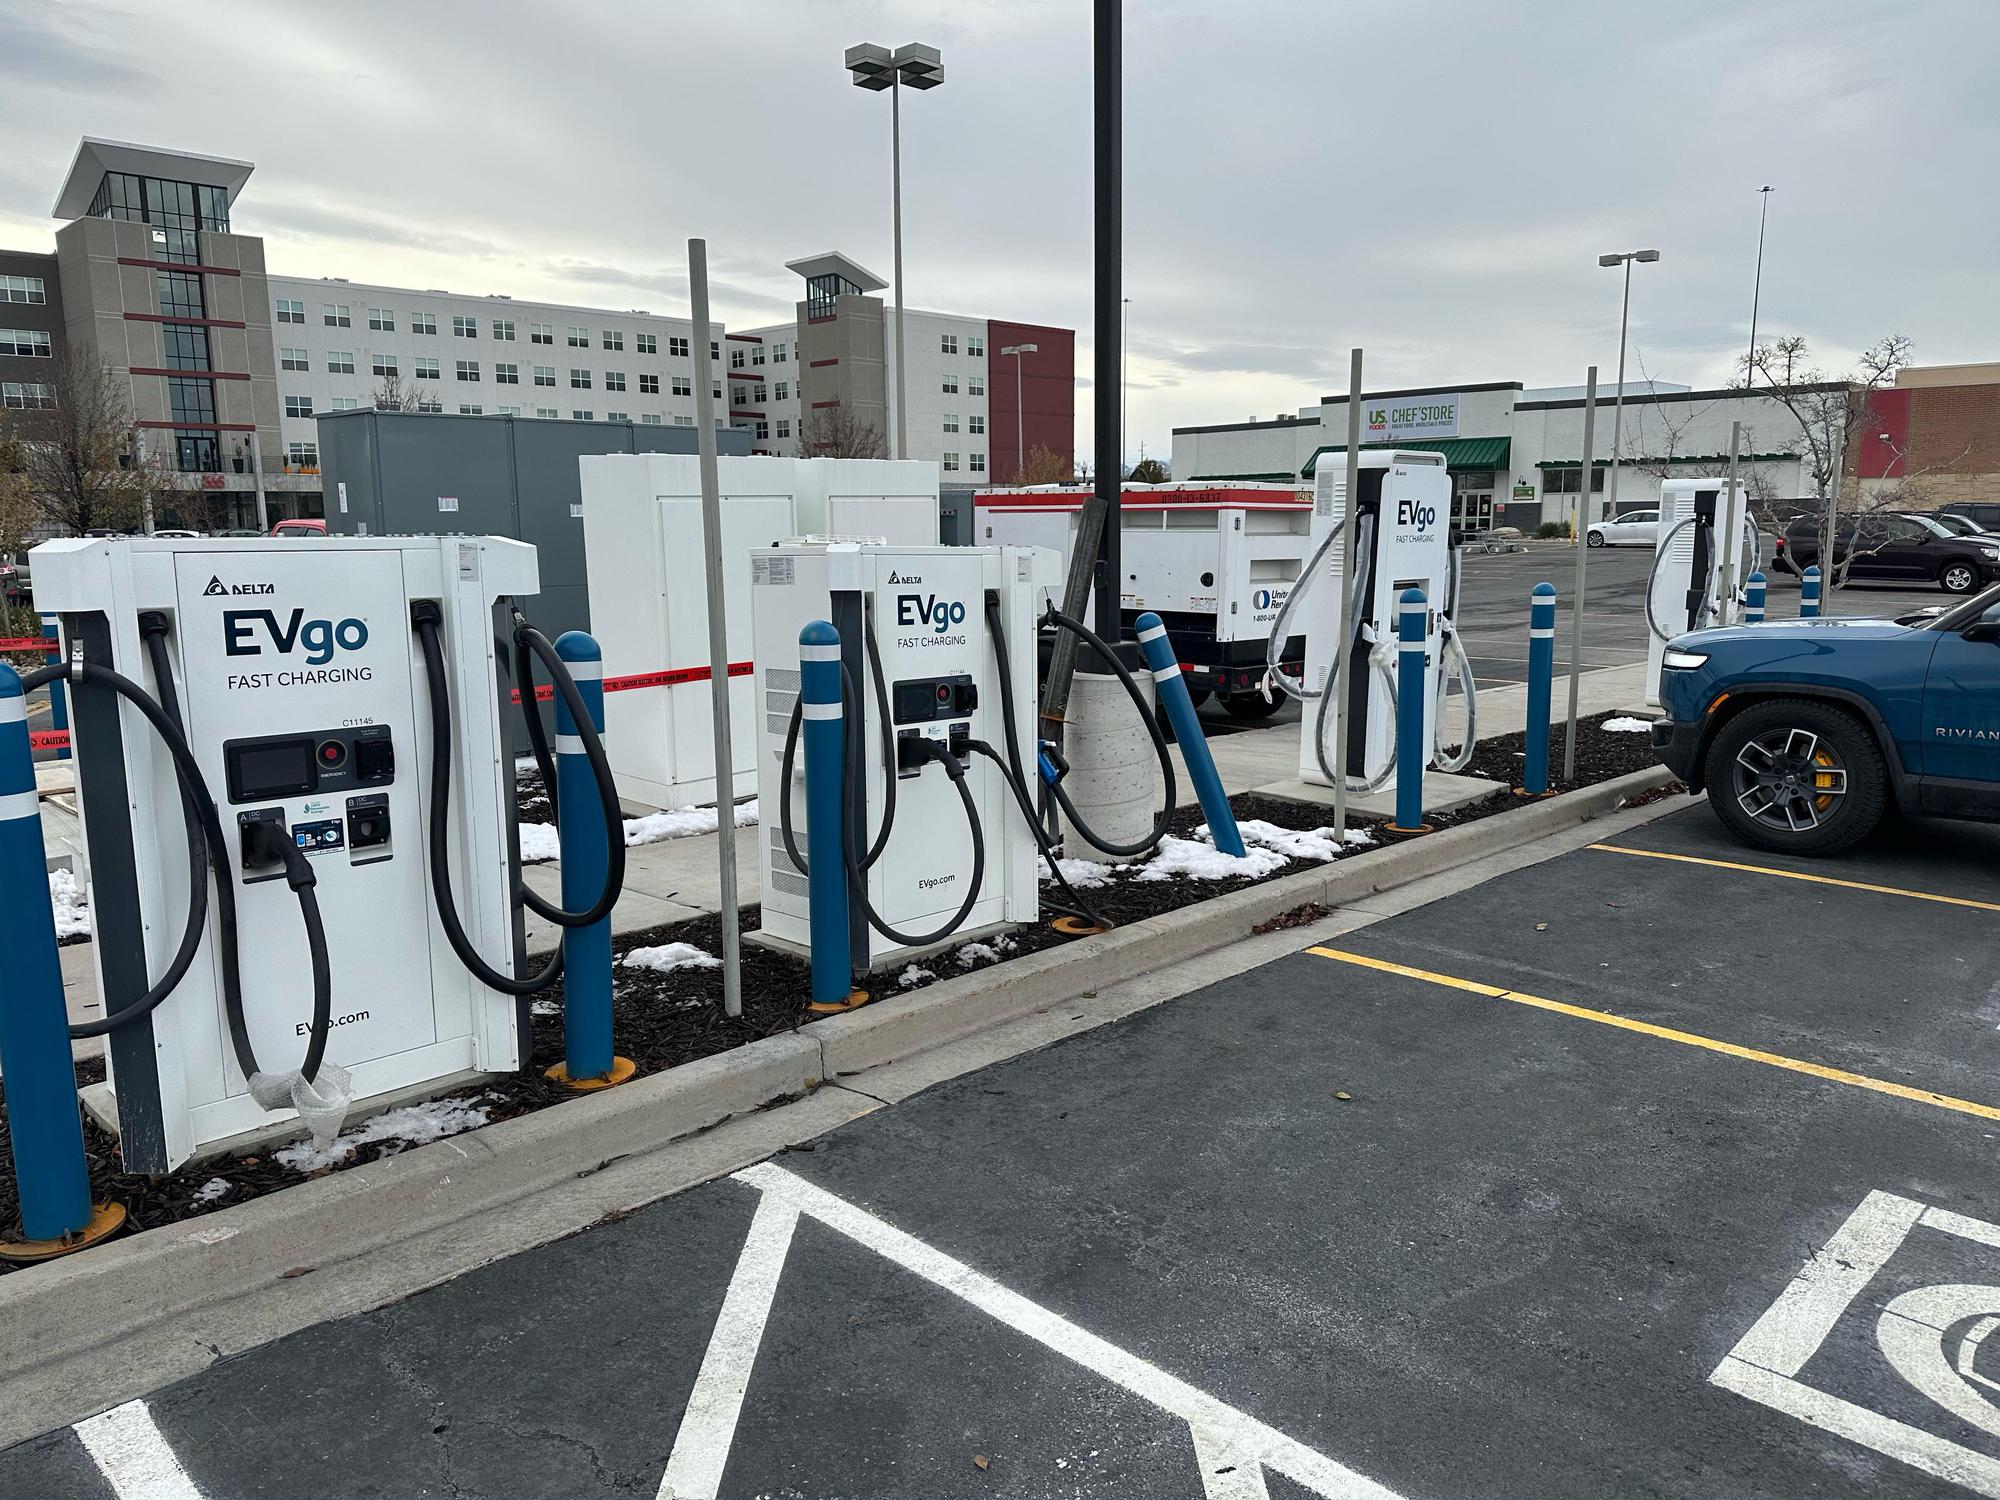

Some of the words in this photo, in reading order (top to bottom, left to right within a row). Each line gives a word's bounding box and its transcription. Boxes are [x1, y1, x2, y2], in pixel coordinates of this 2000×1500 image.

[1391, 405, 1455, 423] CHEF'STORE
[1397, 500, 1436, 533] EVgo
[1395, 535, 1409, 543] FAST
[1409, 534, 1435, 542] CHARGING
[901, 576, 922, 584] DELTA
[231, 583, 275, 596] DELTA
[897, 593, 966, 634] EVgo
[1252, 613, 1277, 622] 1-800-UR
[223, 607, 370, 666] EVgo
[897, 637, 920, 649] FAST
[920, 635, 966, 647] CHARGING
[227, 673, 274, 690] FAST
[276, 667, 373, 687] CHARGING
[342, 717, 374, 727] C11145
[1935, 727, 2000, 740] RIVIAN
[41, 735, 70, 746] CAUTION
[348, 799, 355, 807] B
[240, 814, 248, 822] A
[918, 874, 956, 889] EVgo.com
[295, 1010, 371, 1037] EVo.com
